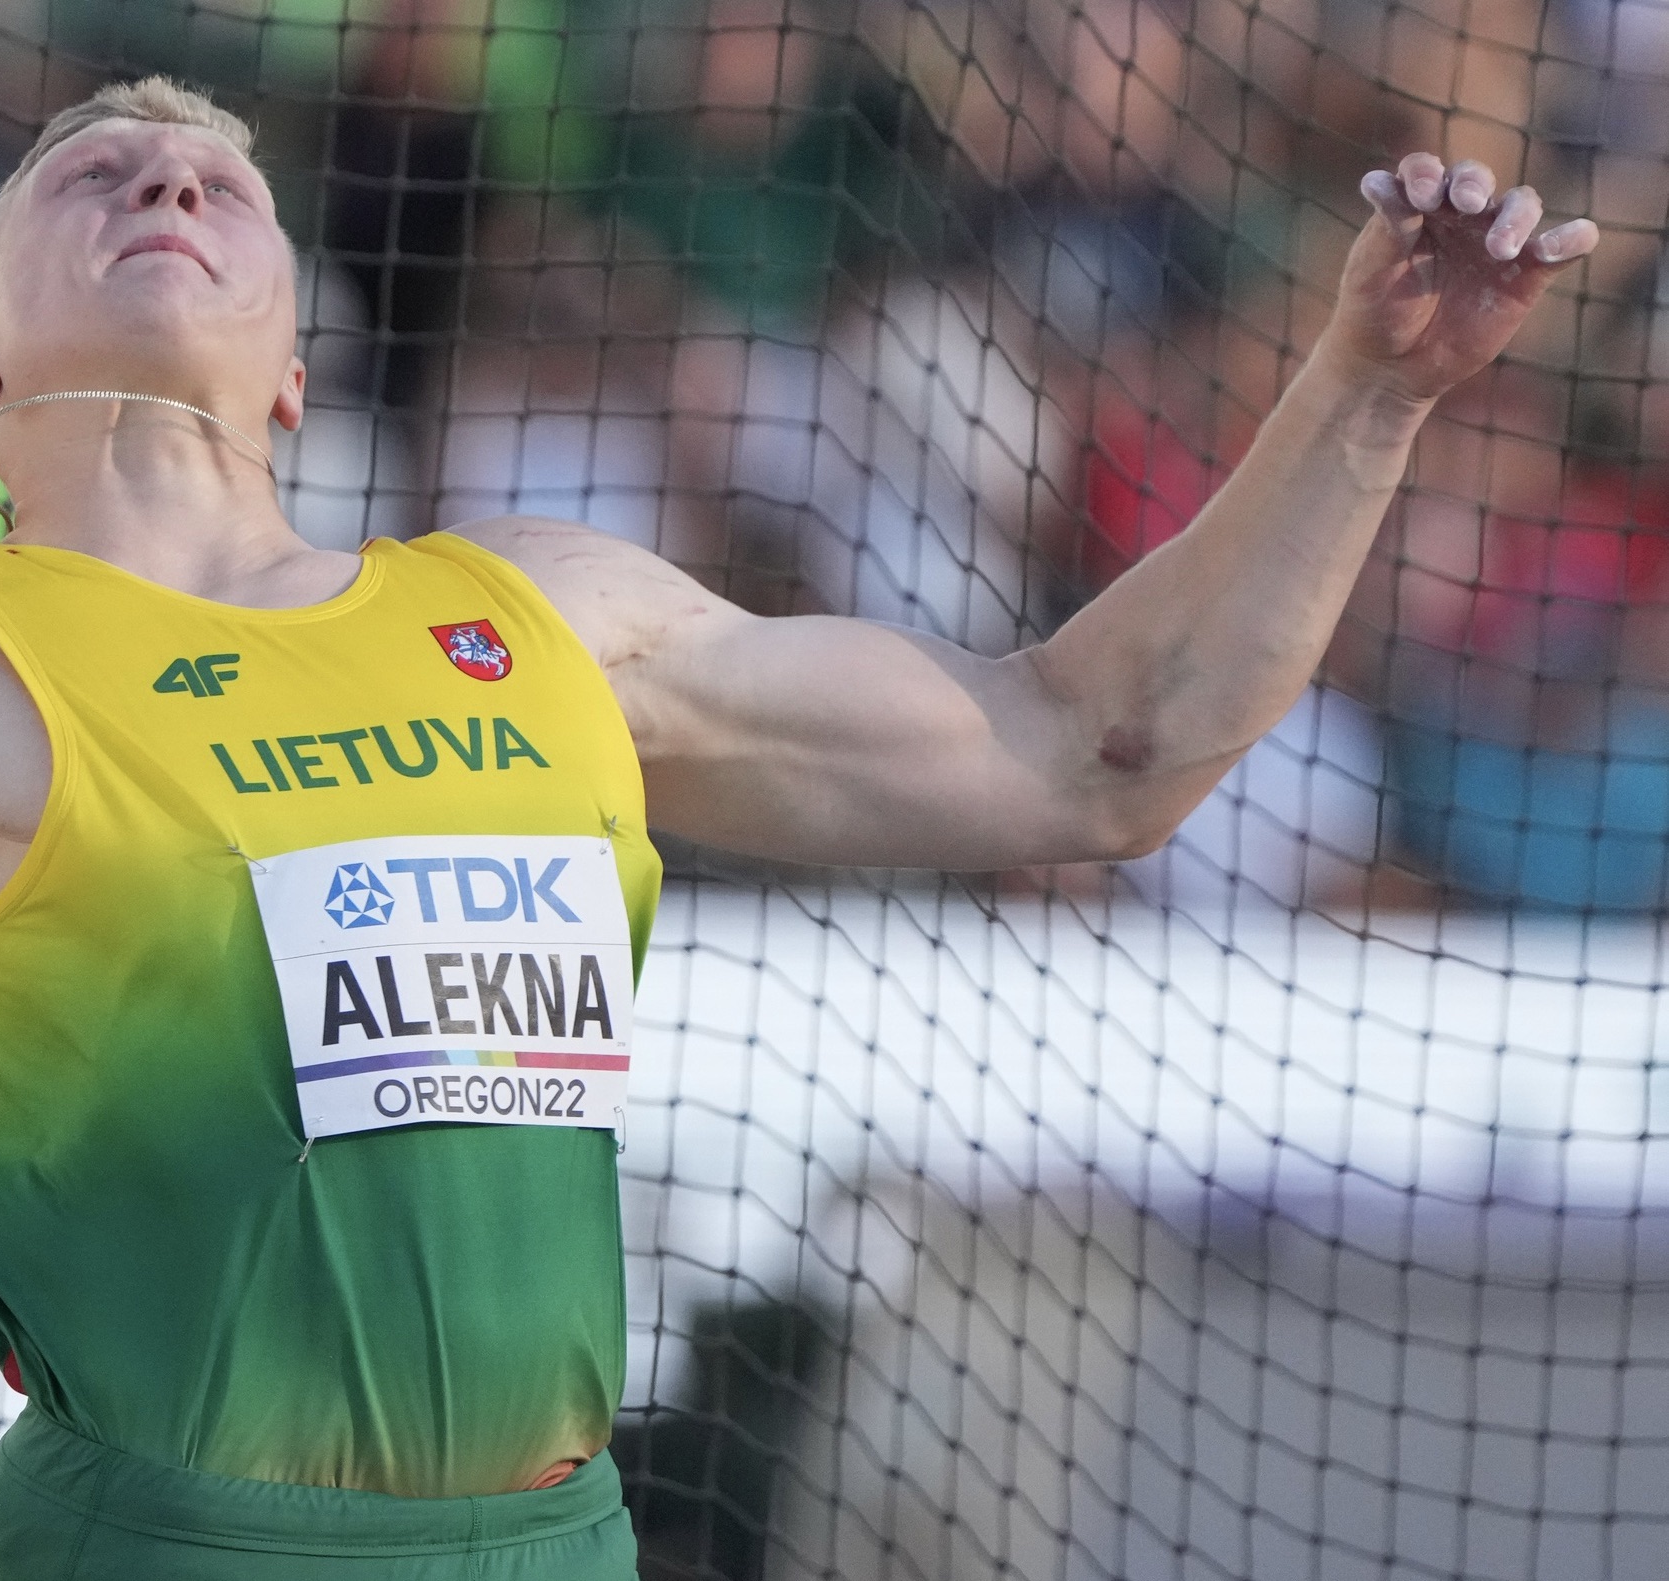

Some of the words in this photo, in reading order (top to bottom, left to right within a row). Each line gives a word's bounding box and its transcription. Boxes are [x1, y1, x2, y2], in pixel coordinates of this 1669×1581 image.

[210, 717, 551, 793] LIETUVA
[386, 857, 583, 923] TDK
[322, 953, 614, 1046] ALEKNA
[374, 1075, 587, 1118] OREGON22
